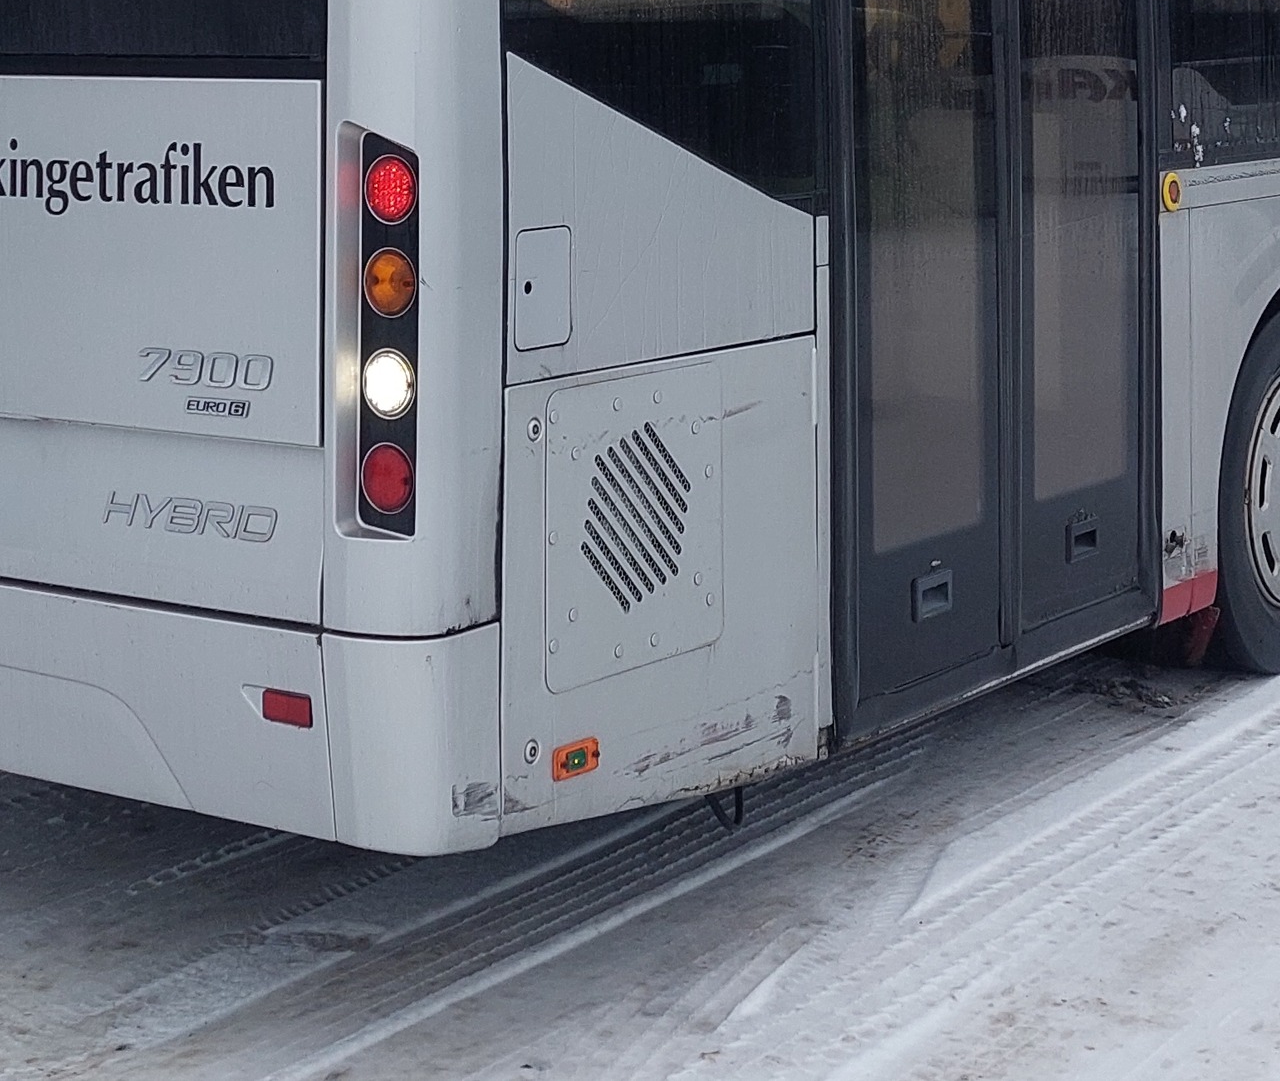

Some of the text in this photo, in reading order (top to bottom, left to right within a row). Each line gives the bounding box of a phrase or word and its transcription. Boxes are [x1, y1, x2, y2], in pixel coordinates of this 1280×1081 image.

[138, 347, 274, 391] 7900
[186, 399, 227, 414] EURO
[103, 491, 279, 543] HYBRID
